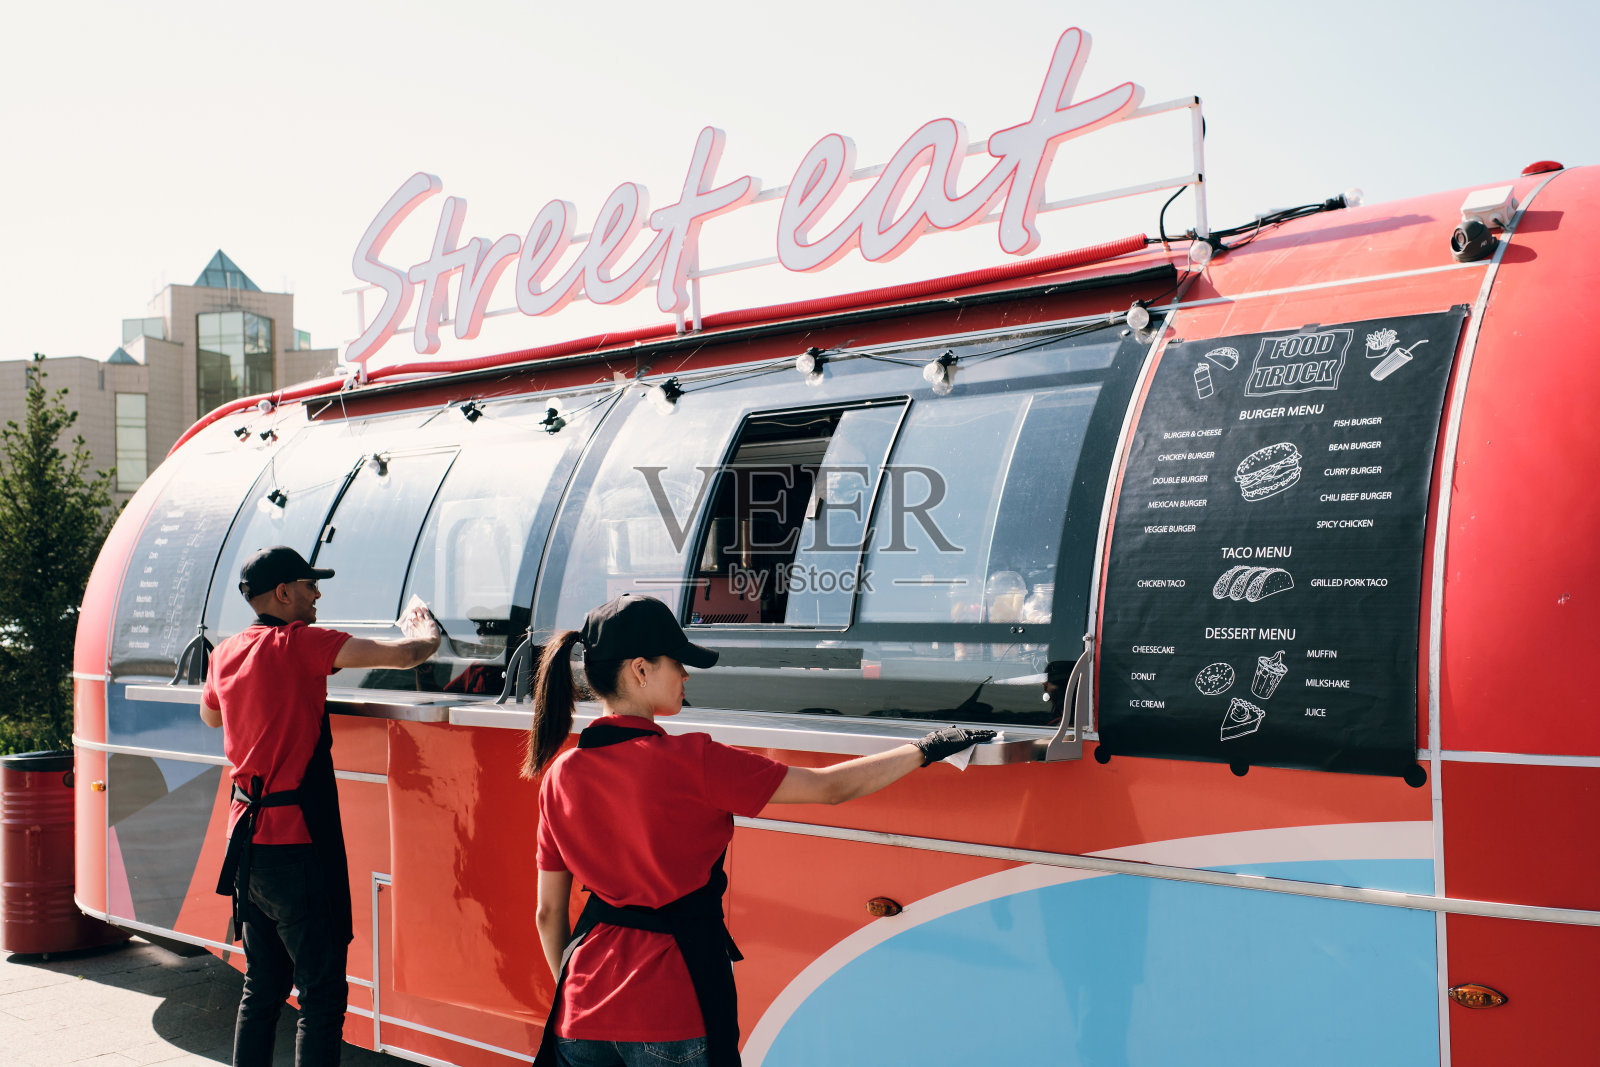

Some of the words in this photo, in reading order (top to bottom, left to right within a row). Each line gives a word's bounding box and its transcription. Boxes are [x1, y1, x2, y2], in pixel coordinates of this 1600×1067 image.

[345, 126, 763, 362] Street
[777, 26, 1146, 274] eat
[1270, 333, 1336, 360] FOOD
[1254, 359, 1338, 388] TRUCK
[1239, 407, 1286, 421] BURGER
[1287, 403, 1326, 417] MENU
[1333, 419, 1351, 428] FISH
[1351, 416, 1383, 426] BURGER
[1163, 430, 1190, 440] BURGER
[1190, 429, 1197, 438] &
[1197, 428, 1223, 438] CHEESE
[1328, 443, 1350, 452] BEAN
[1350, 440, 1382, 450] BURGER
[1158, 453, 1187, 462] CHICKEN
[1187, 451, 1216, 460] BURGER
[1324, 467, 1350, 476] CURRY
[1350, 465, 1383, 475] BURGER
[1152, 476, 1180, 485] DOUBLE
[1180, 475, 1209, 484] BURGER
[1319, 493, 1340, 502] CHILI
[1340, 492, 1360, 502] BEEF
[1360, 491, 1393, 501] BURGER
[1147, 501, 1179, 509] MEXICAN
[1179, 499, 1208, 508] BURGER
[1144, 525, 1169, 534] VEGGIE
[1168, 524, 1197, 533] BURGER
[1316, 520, 1338, 529] SPICY
[1338, 519, 1374, 529] CHICKEN
[1221, 546, 1253, 559] TACO
[1255, 545, 1293, 558] MENU
[1137, 579, 1167, 588] CHICKEN
[1167, 579, 1186, 588] TACO
[1310, 578, 1343, 587] GRILLED
[1343, 578, 1366, 587] PORK
[1366, 578, 1389, 587] TACO
[1205, 627, 1256, 640] DESSERT
[1258, 628, 1297, 641] MENU
[1132, 645, 1176, 655] CHEESECAKE
[1306, 649, 1338, 658] MUFFIN
[1131, 672, 1157, 681] DONUT
[1305, 678, 1351, 689] MILKSHAKE
[1129, 699, 1140, 708] ICE
[1140, 700, 1165, 709] CREAM
[1304, 708, 1327, 717] JUICE
